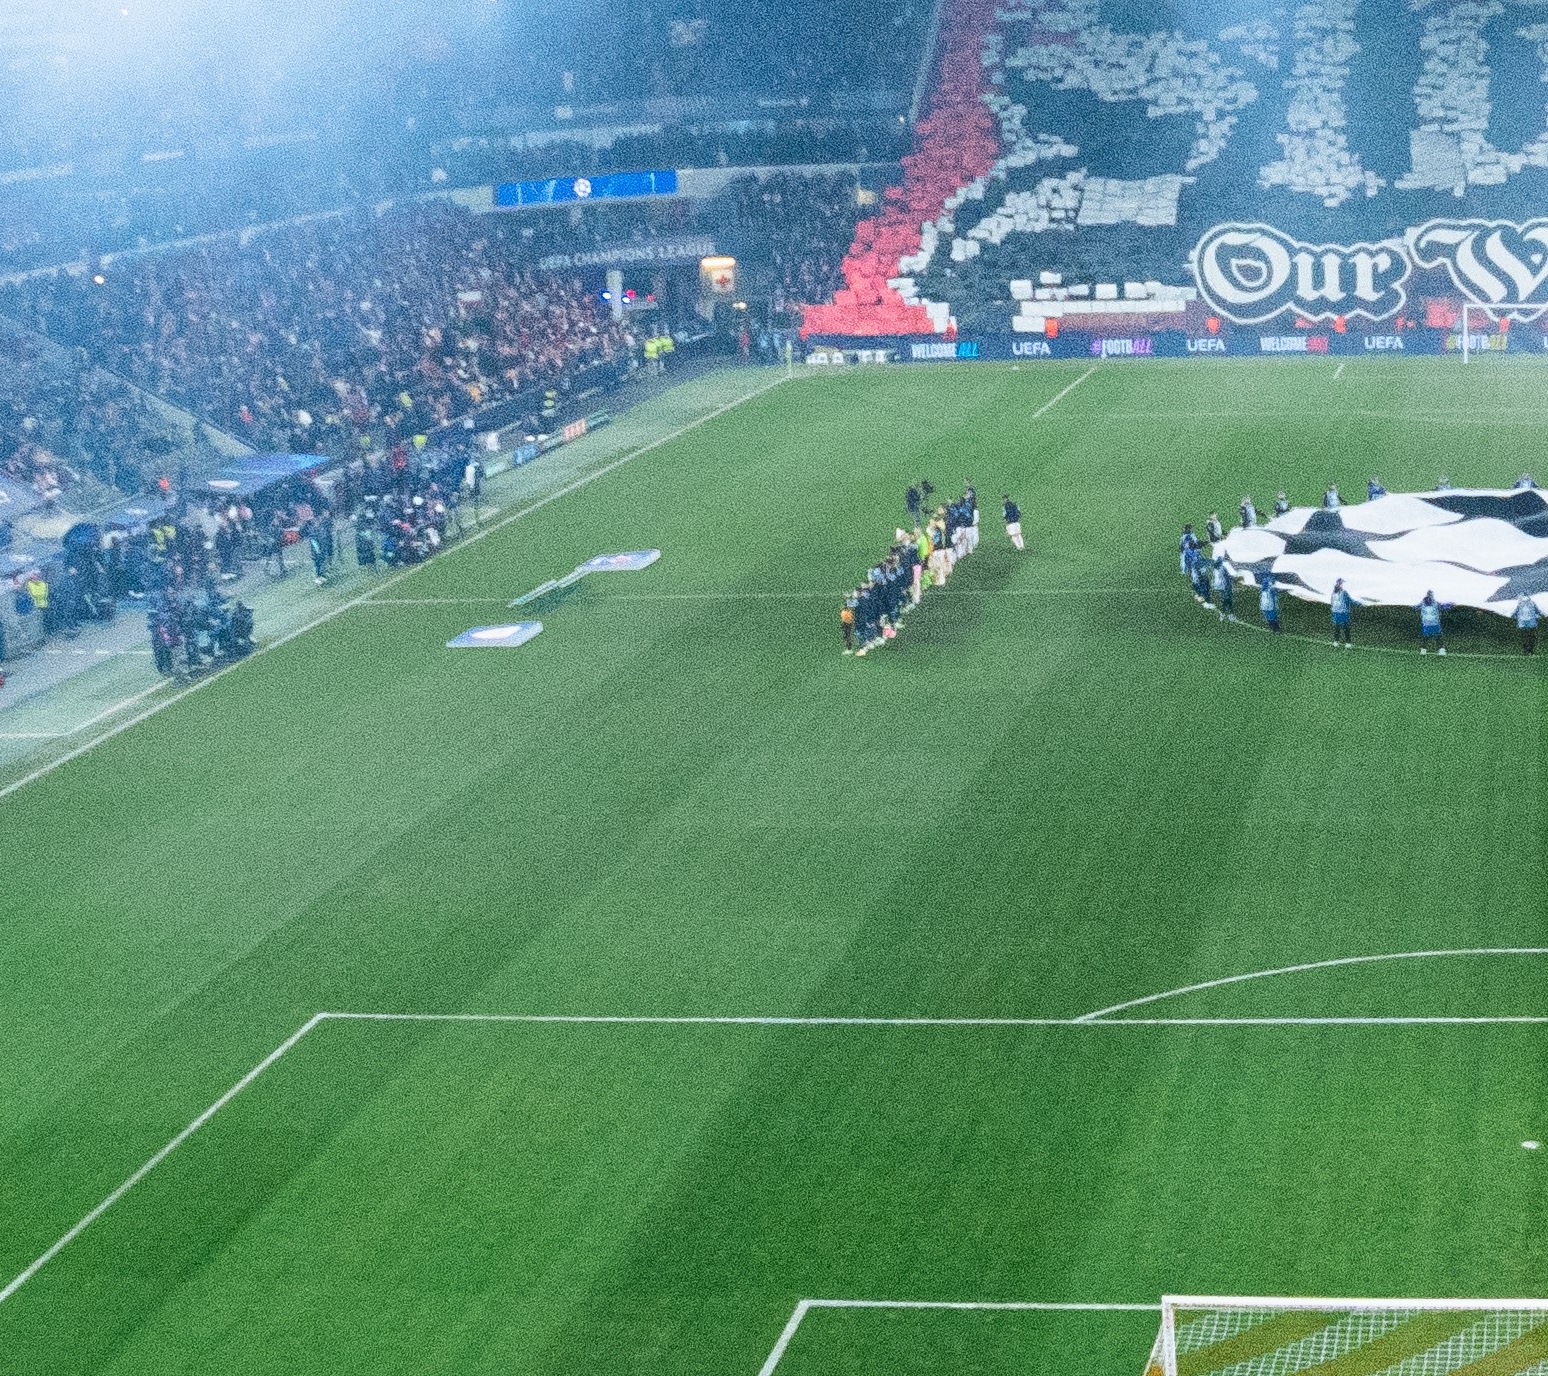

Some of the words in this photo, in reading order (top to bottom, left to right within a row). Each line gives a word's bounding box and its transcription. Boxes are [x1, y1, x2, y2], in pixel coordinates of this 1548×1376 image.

[1203, 229, 1390, 303] Our
[1012, 342, 1051, 356] UEFA
[1187, 339, 1226, 353] UEFA
[1364, 336, 1404, 350] UEFA
